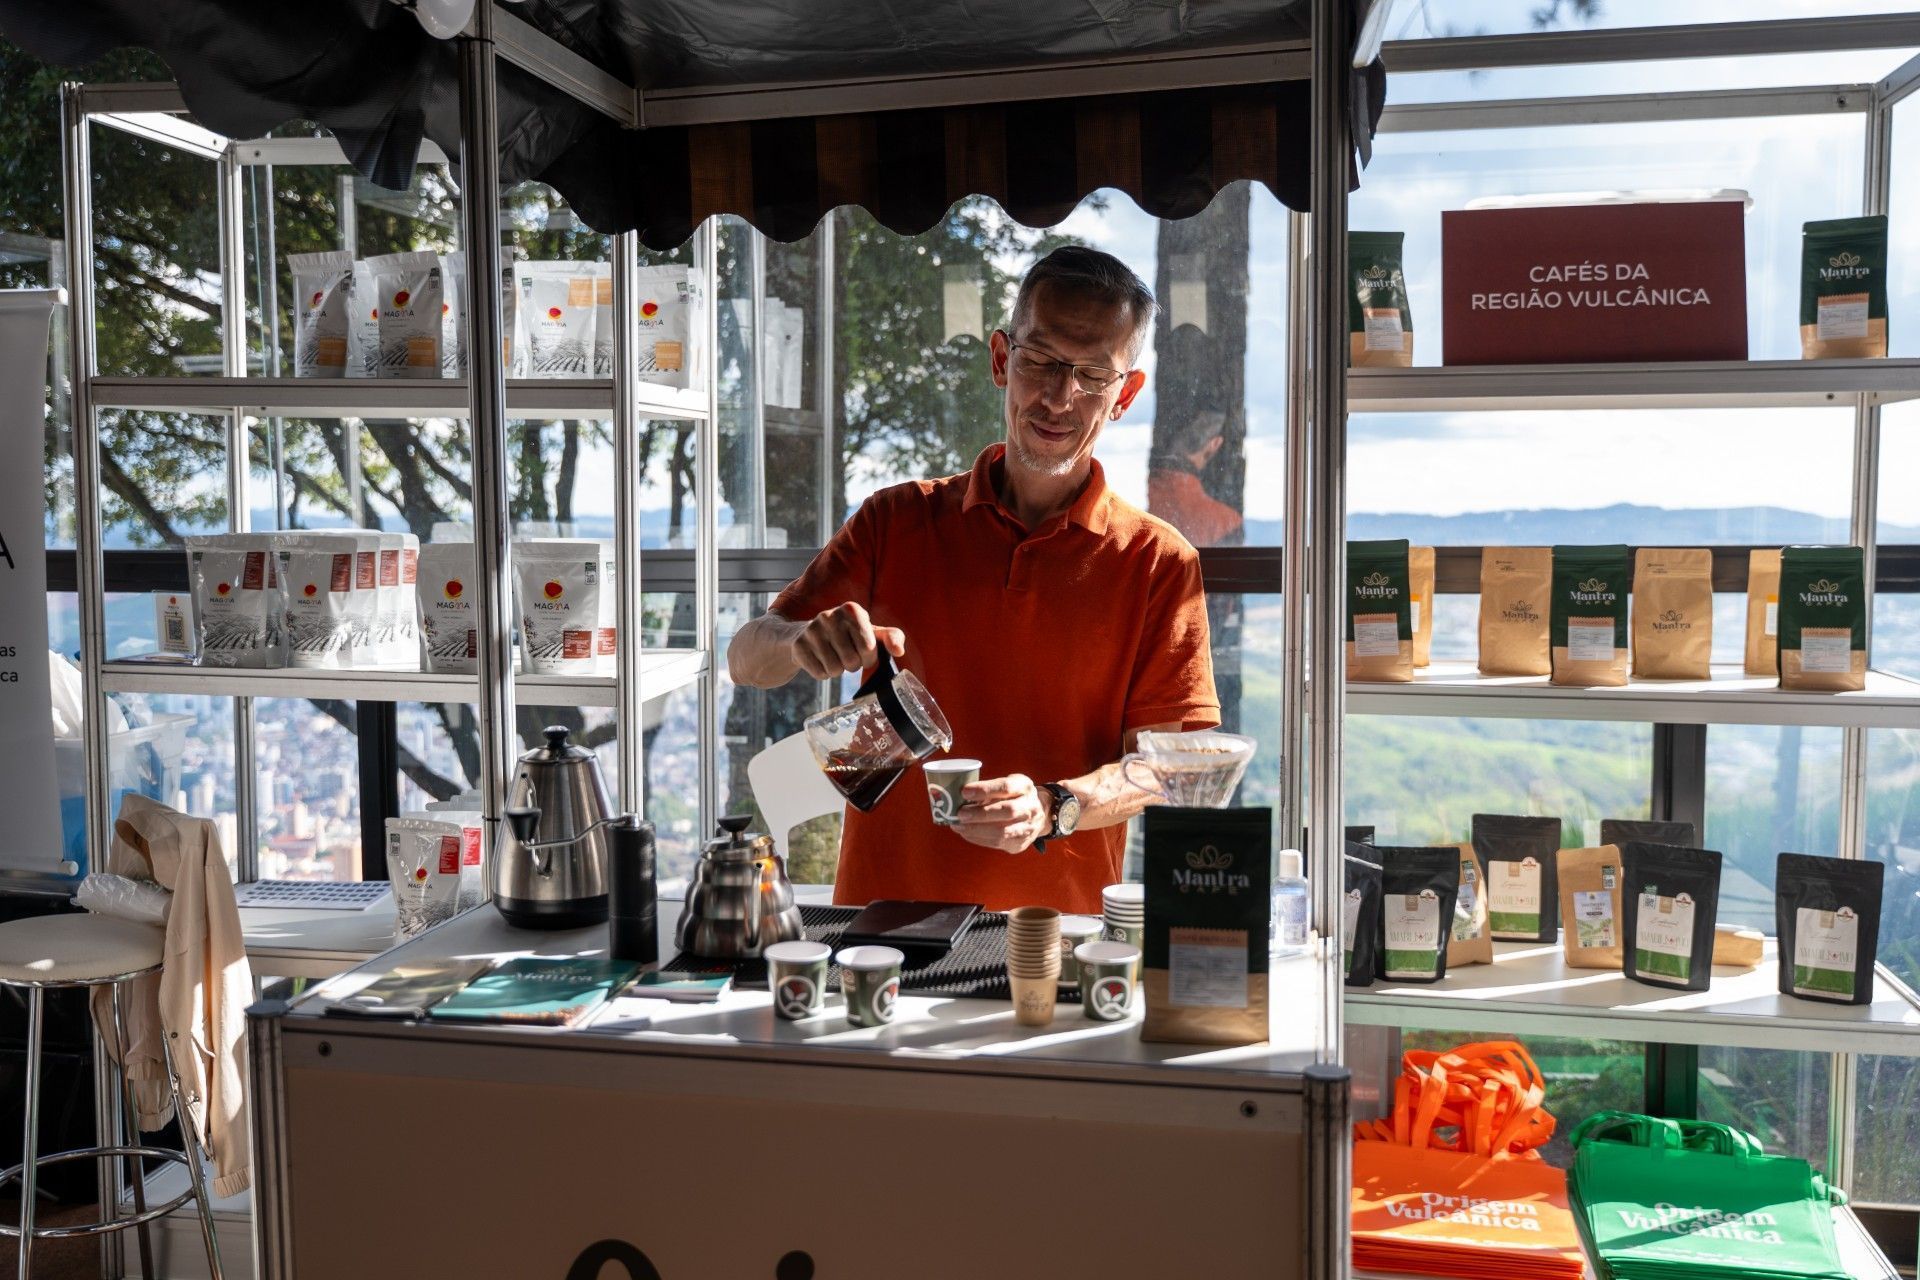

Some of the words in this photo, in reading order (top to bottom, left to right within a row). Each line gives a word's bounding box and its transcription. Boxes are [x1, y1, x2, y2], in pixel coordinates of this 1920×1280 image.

[1529, 260, 1608, 283] CAFÉS
[1615, 263, 1650, 281] DA
[1820, 266, 1870, 279] Mantra
[1358, 278, 1397, 289] Mantra
[1471, 288, 1563, 310] REGIÃO
[1567, 286, 1711, 308] VULCÂNICA
[639, 319, 664, 327] AGMA
[1355, 586, 1399, 596] Mantra
[1570, 591, 1616, 601] Mantra
[1800, 592, 1849, 603] Mantra
[436, 602, 471, 610] MAGMA
[534, 602, 570, 611] MAGMA
[1172, 868, 1250, 888] Mantra
[1420, 1192, 1538, 1216] Origem
[1384, 1200, 1542, 1232] Vulcânica
[1654, 1202, 1777, 1226] Origem
